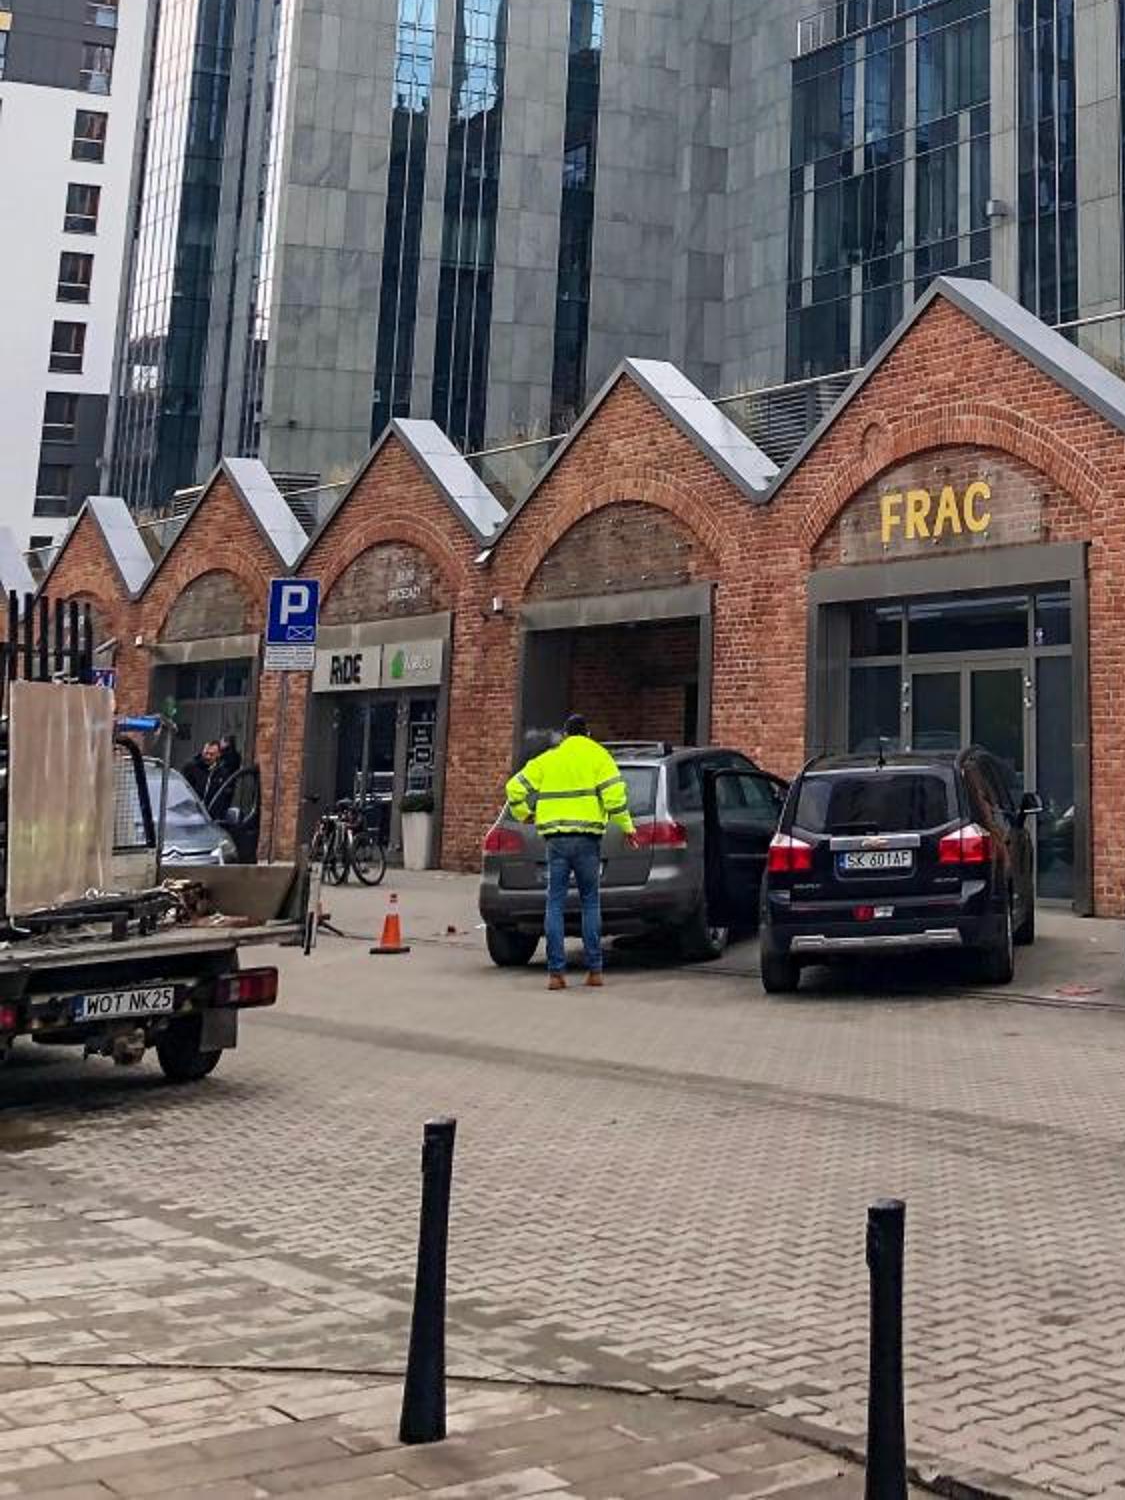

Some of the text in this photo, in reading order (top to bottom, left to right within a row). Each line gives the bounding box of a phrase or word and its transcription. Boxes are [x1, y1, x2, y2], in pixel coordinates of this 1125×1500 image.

[881, 481, 991, 543] FRAC
[280, 585, 310, 625] P
[87, 989, 172, 1015] WOT NK25
